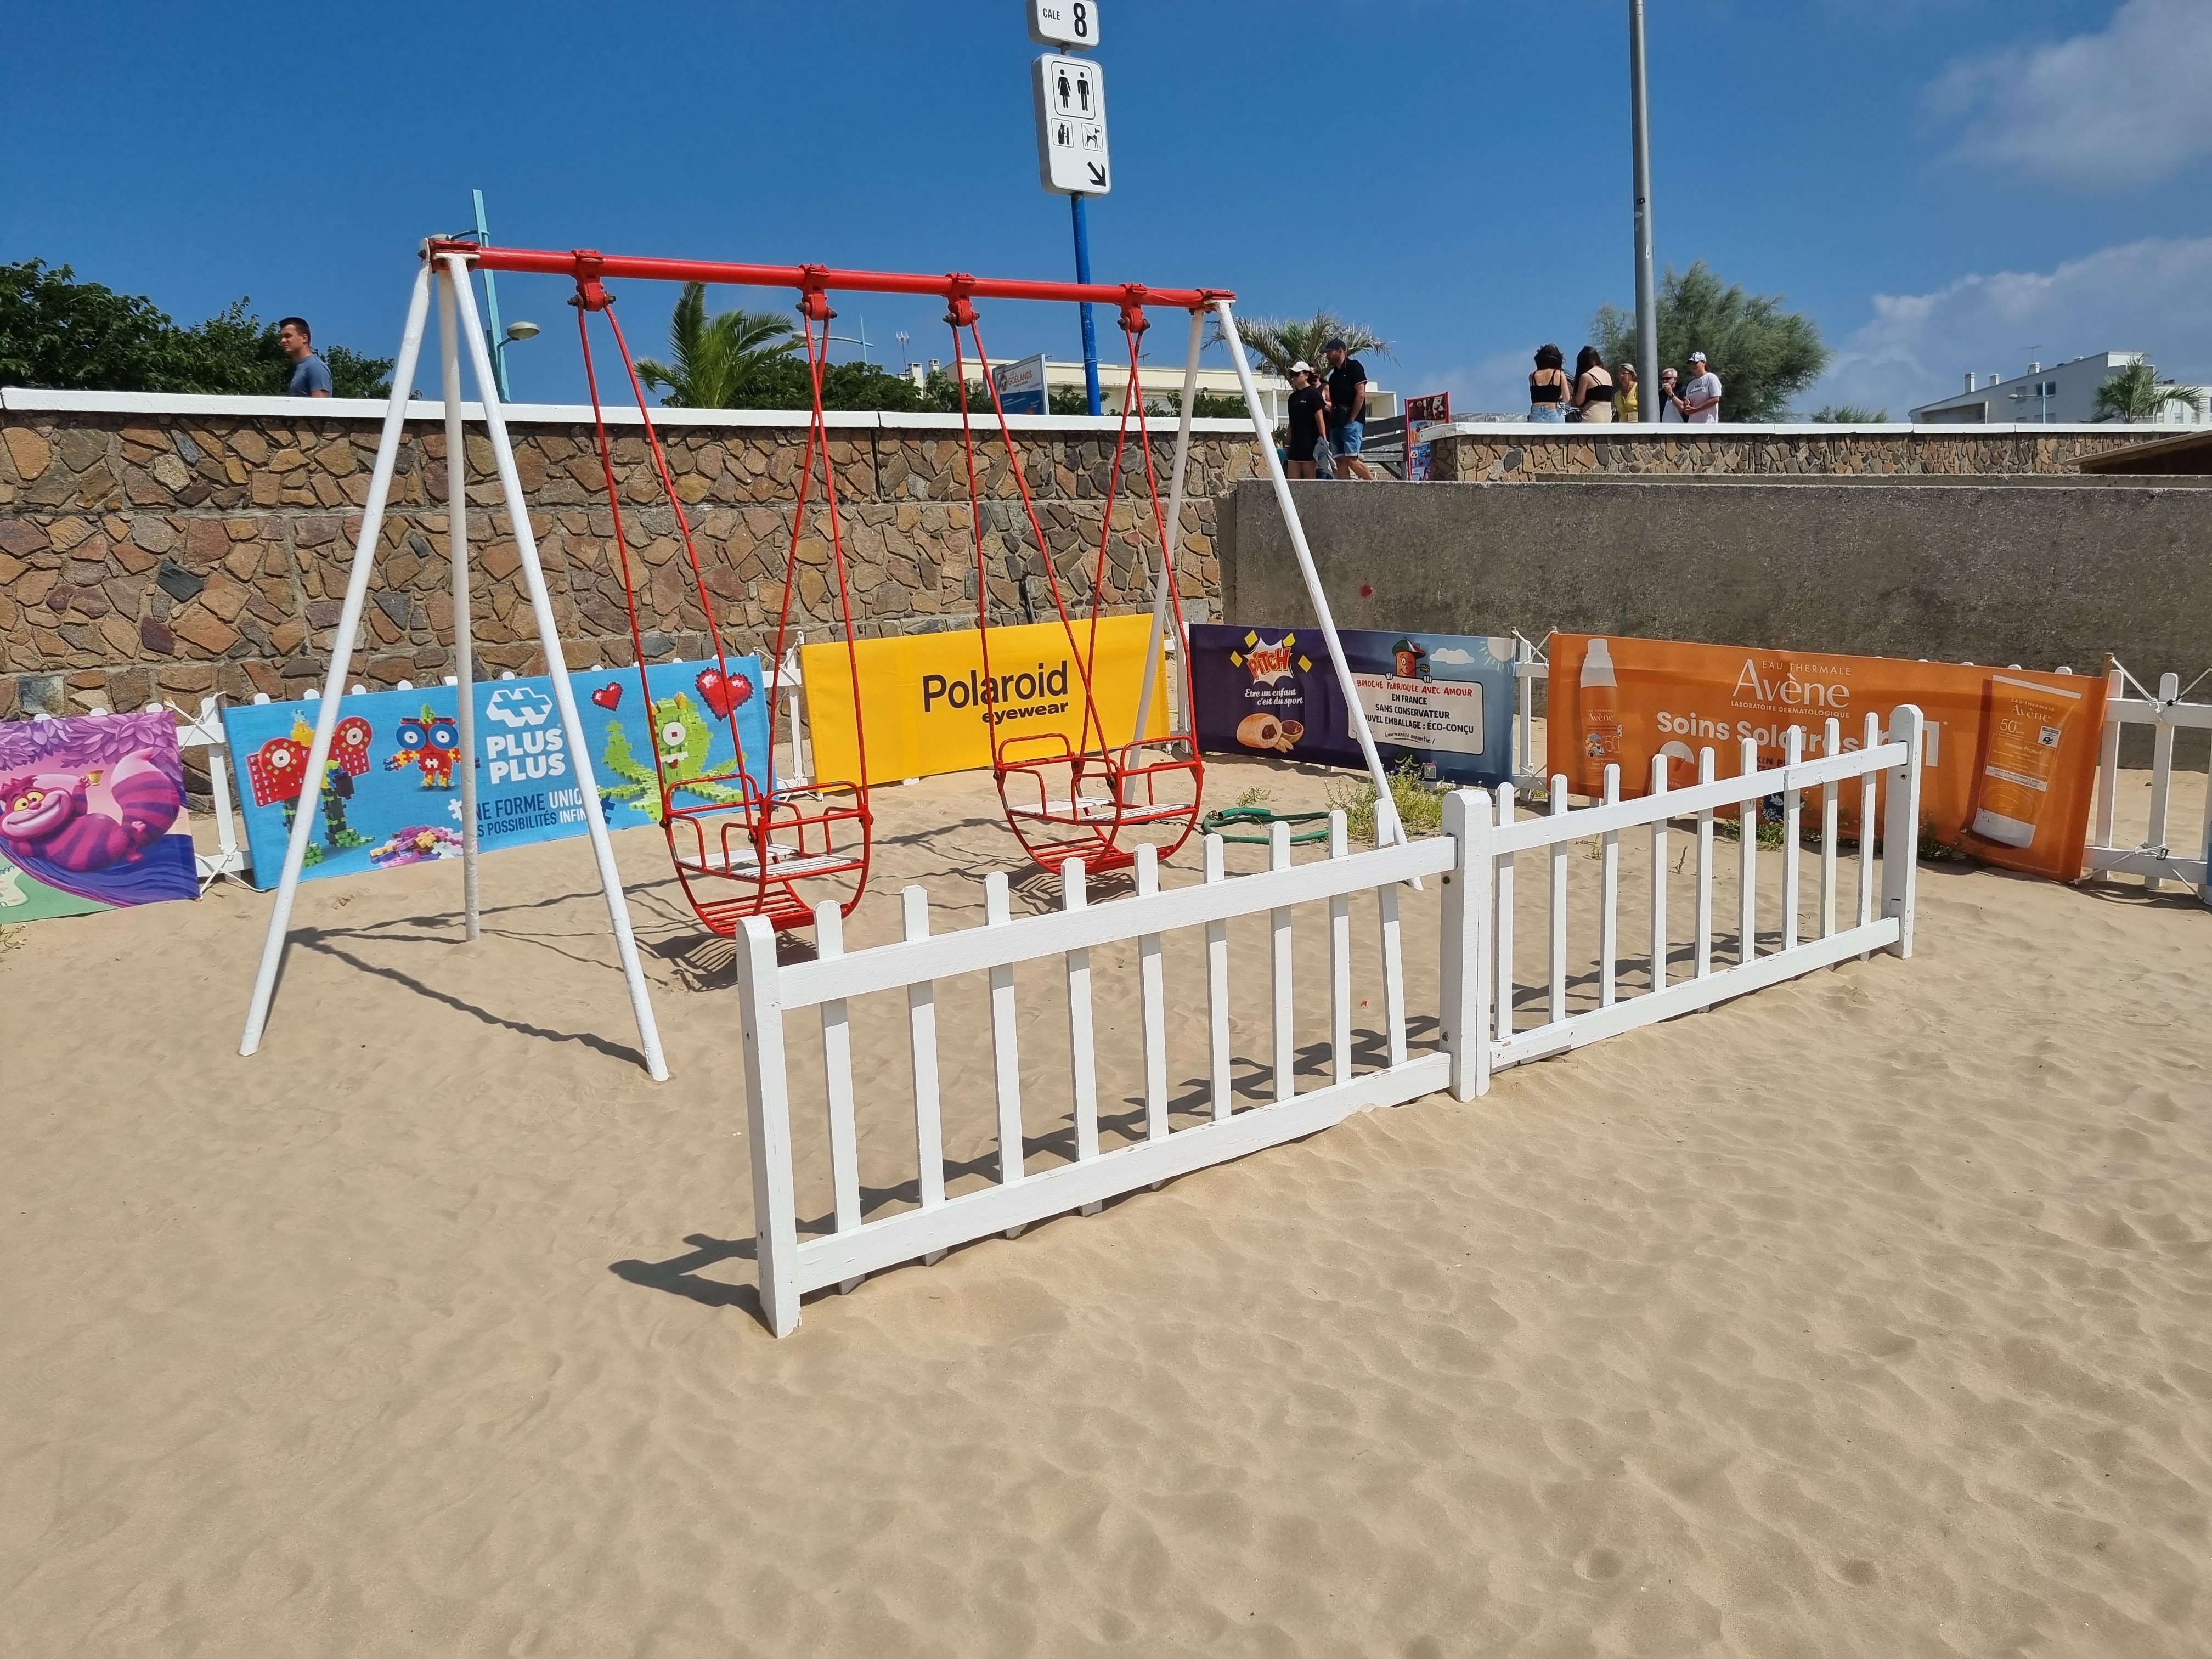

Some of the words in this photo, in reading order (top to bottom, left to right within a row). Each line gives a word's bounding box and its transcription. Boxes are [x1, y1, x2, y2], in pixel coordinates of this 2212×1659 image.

[1043, 8, 1060, 20] CALE
[1073, 2, 1087, 37] 8
[1762, 661, 1782, 670] EAU
[1790, 663, 1851, 675] THERMALE
[923, 660, 1068, 713] Polaroid
[1272, 687, 1296, 698] enfant
[1357, 679, 1384, 689] BRIOCHE
[1387, 682, 1419, 692] FABRIQUÉE
[1421, 686, 1441, 695] AVEC
[1444, 687, 1472, 697] AMOUR
[1732, 659, 1850, 708] Avène
[1283, 697, 1304, 707] sport
[1402, 695, 1427, 705] FRANCE
[1731, 701, 1776, 712] LABORATOIRE
[1779, 707, 1850, 718] DERMATOLOGIQUE
[982, 702, 1069, 725] eyewear
[1375, 704, 1393, 713] SANS
[1395, 706, 1450, 719] CONSERVATEUR
[1588, 713, 1613, 721] Avène
[1364, 714, 1384, 723] UVEL
[1385, 716, 1421, 729] EMBALLAGE
[1427, 720, 1474, 735] ÉCO-CONÇU
[1657, 711, 1730, 741] Soins
[487, 728, 563, 759] PLUS
[1410, 735, 1430, 743] garantie
[489, 753, 566, 784] PLUS
[476, 802, 491, 821] NE
[495, 793, 545, 817] FORME
[488, 810, 557, 836] POSSIBILITÉS
